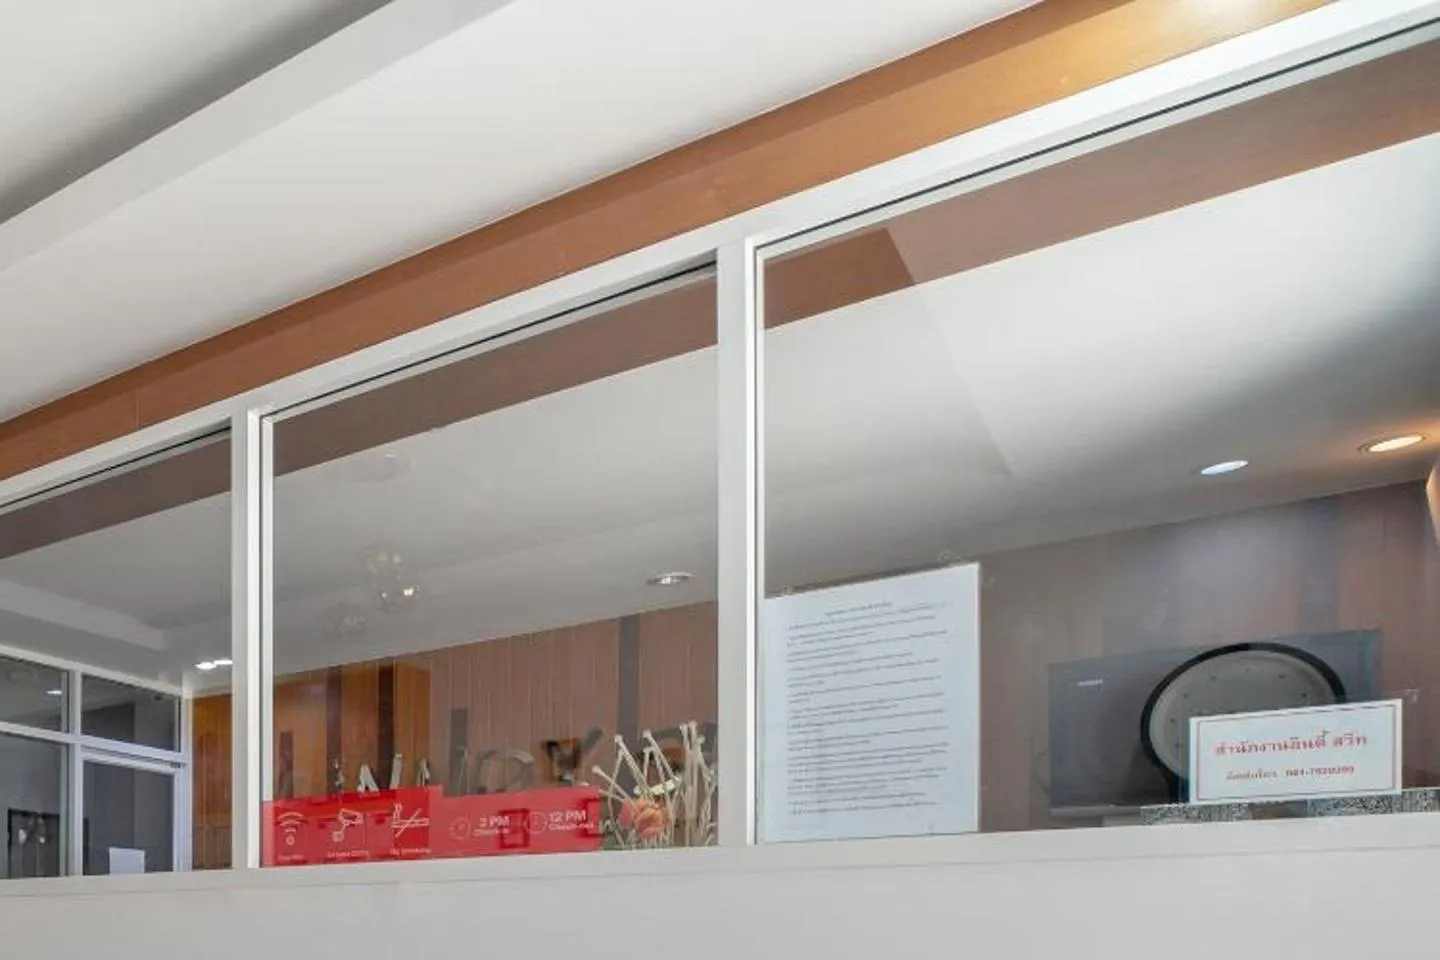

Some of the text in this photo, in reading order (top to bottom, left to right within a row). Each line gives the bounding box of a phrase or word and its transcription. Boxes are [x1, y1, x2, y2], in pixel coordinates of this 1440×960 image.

[489, 814, 510, 826] PM
[549, 809, 588, 823] 12 PM
